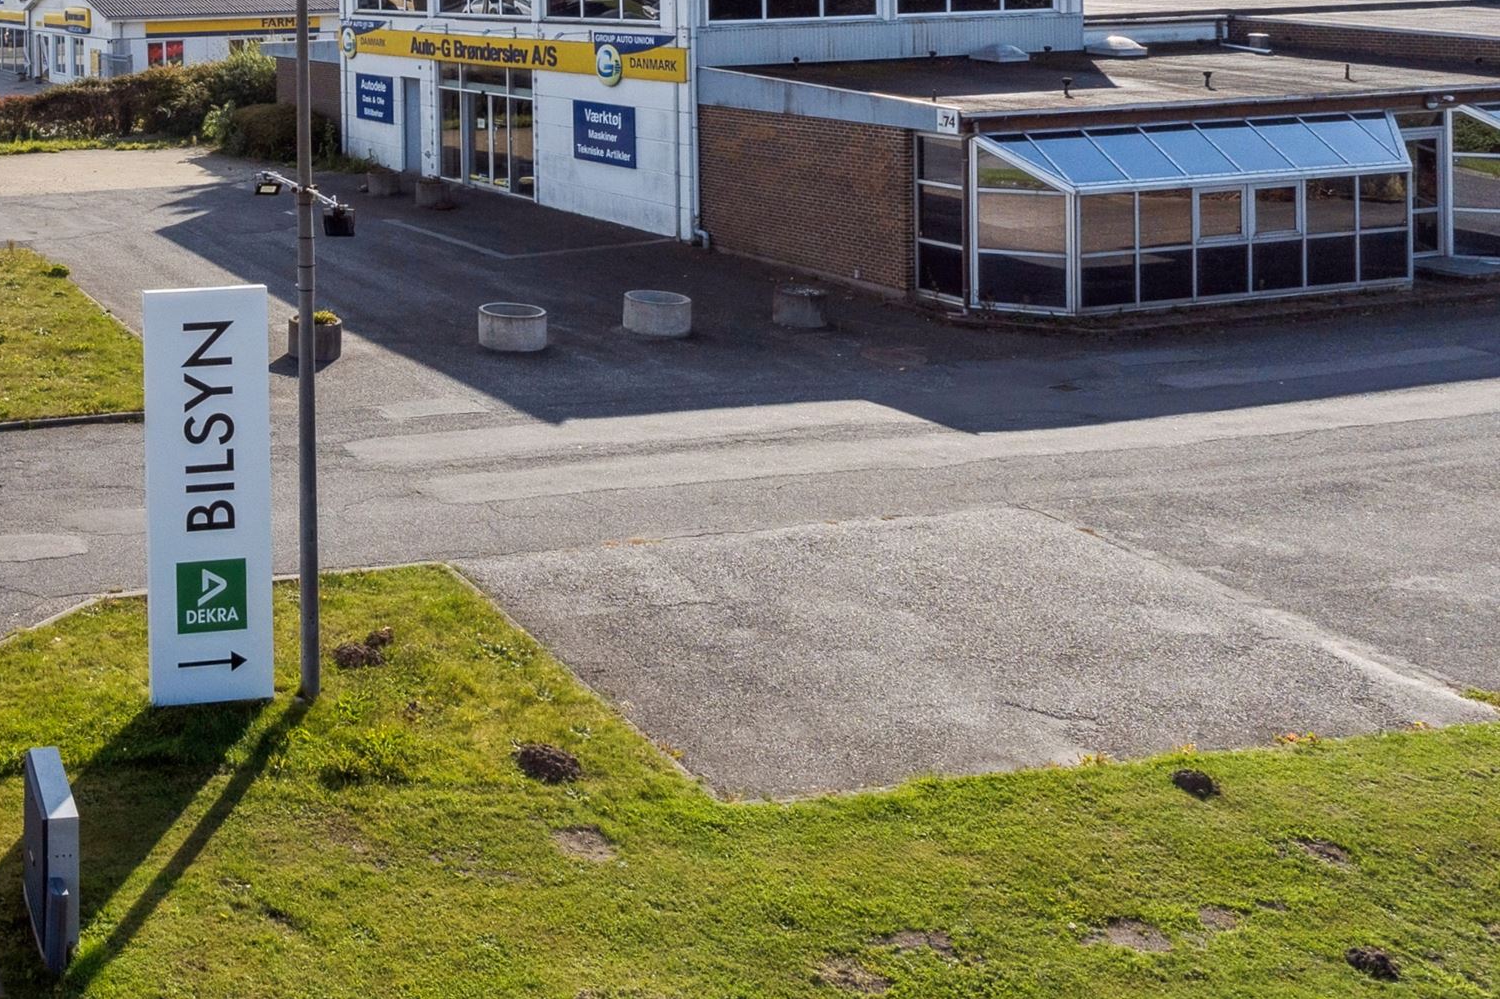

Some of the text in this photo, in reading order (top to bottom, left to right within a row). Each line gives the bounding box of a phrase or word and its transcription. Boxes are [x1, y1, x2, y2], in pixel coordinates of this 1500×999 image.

[595, 34, 655, 45] GROUP AUTO UNION
[411, 37, 558, 67] Auto-G Brønderslev A/S
[630, 57, 677, 72] DANMARK
[360, 79, 386, 92] Autodele
[584, 108, 622, 129] Værktøj
[943, 115, 956, 128] 74
[588, 129, 618, 142] Maskiner
[577, 143, 631, 162] Tekniske Artikler
[181, 320, 235, 532] BILSYN
[186, 606, 240, 625] DEKRA
